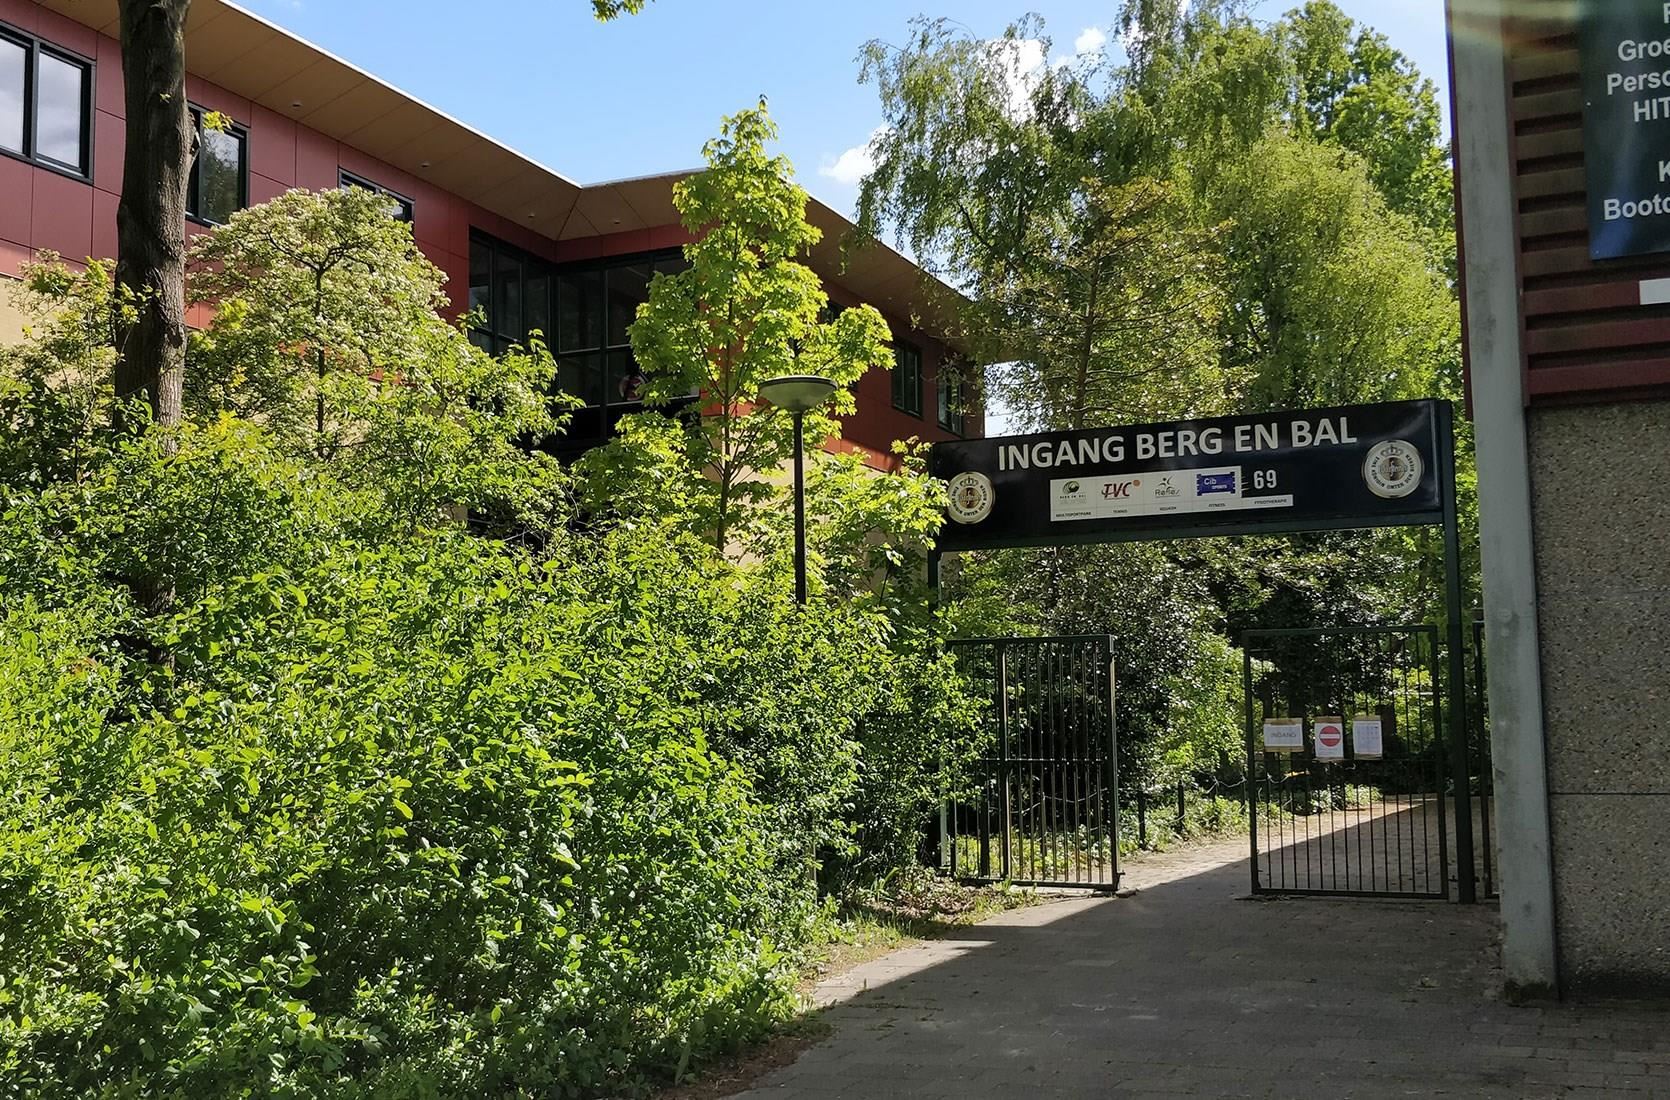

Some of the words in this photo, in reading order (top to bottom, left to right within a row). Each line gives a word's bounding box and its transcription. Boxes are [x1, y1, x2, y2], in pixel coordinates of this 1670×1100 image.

[999, 436, 1125, 471] INGANG
[1136, 428, 1222, 460] BERG
[1234, 423, 1279, 452] EN
[1291, 416, 1358, 448] BAL
[1101, 481, 1132, 499] TVC
[1253, 469, 1277, 490] 69
